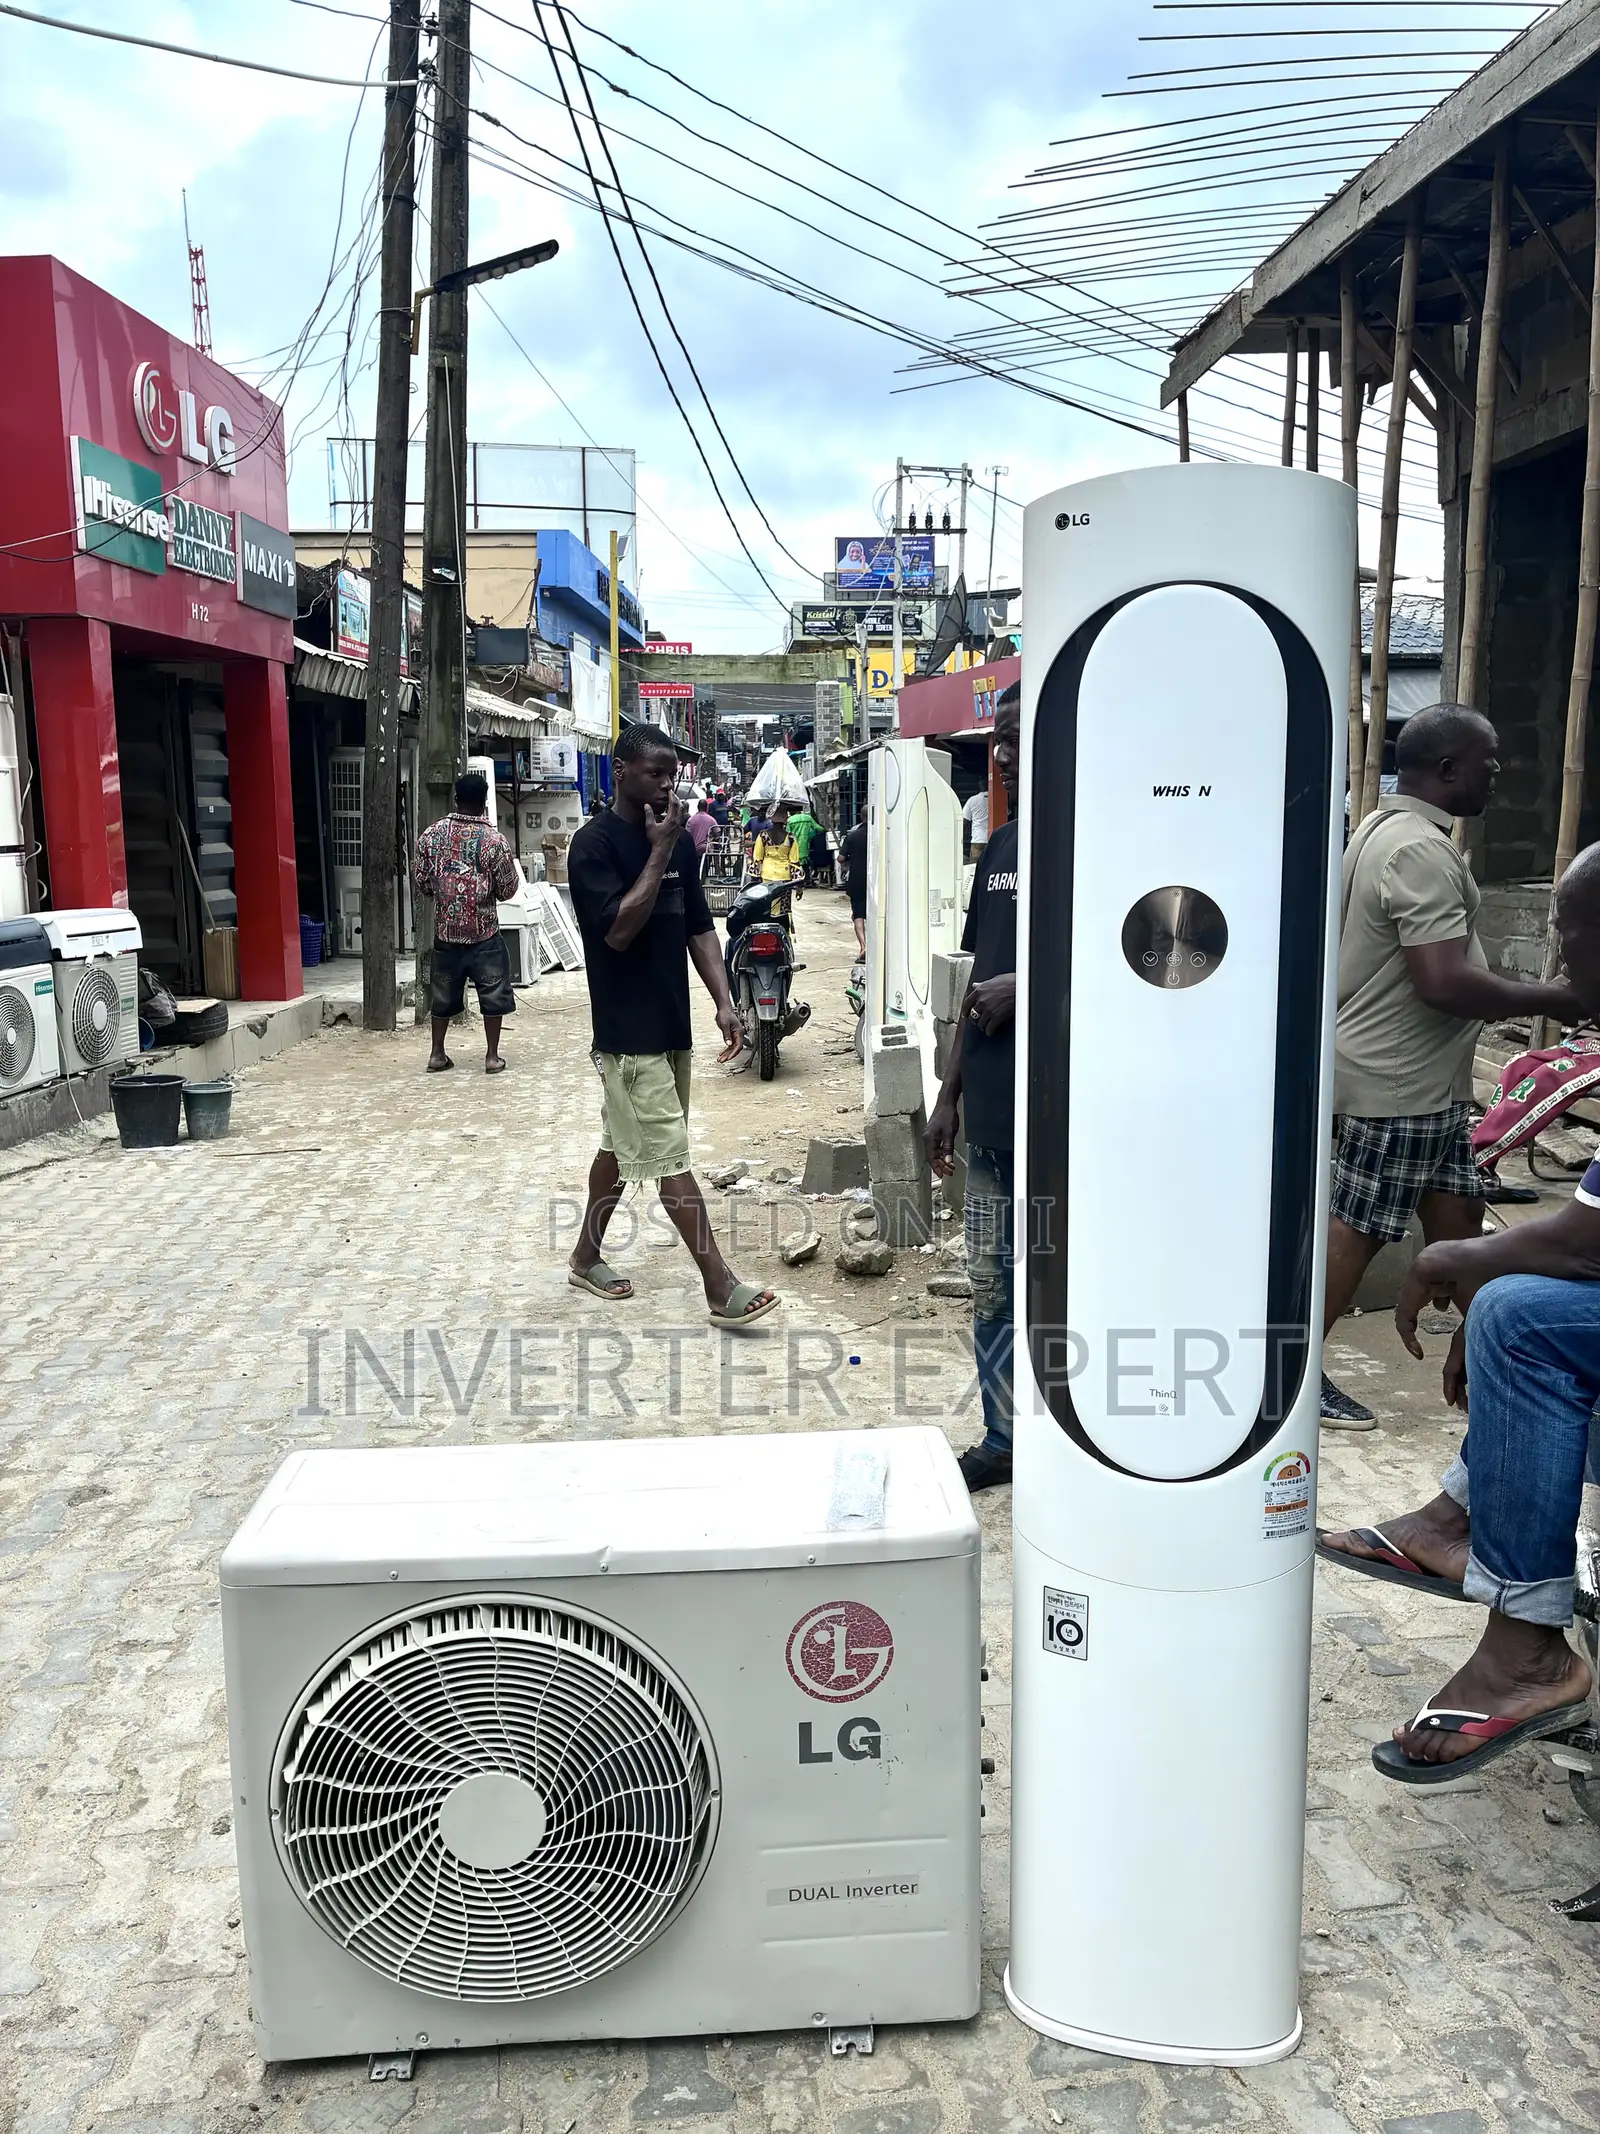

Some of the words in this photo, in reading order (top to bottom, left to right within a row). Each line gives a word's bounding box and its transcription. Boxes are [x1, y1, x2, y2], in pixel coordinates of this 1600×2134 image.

[178, 389, 236, 476] LG
[83, 475, 170, 543] Hisense
[172, 496, 233, 550] DANNY
[1072, 513, 1090, 526] LG
[173, 535, 236, 584] ELECTRONICS
[191, 602, 199, 619] H
[199, 605, 209, 622] 72
[987, 872, 1018, 891] EARN
[1149, 1388, 1178, 1399] ThinQ
[798, 1716, 882, 1765] LG
[788, 1886, 840, 1902] DUAL
[846, 1882, 918, 1898] Inverter
